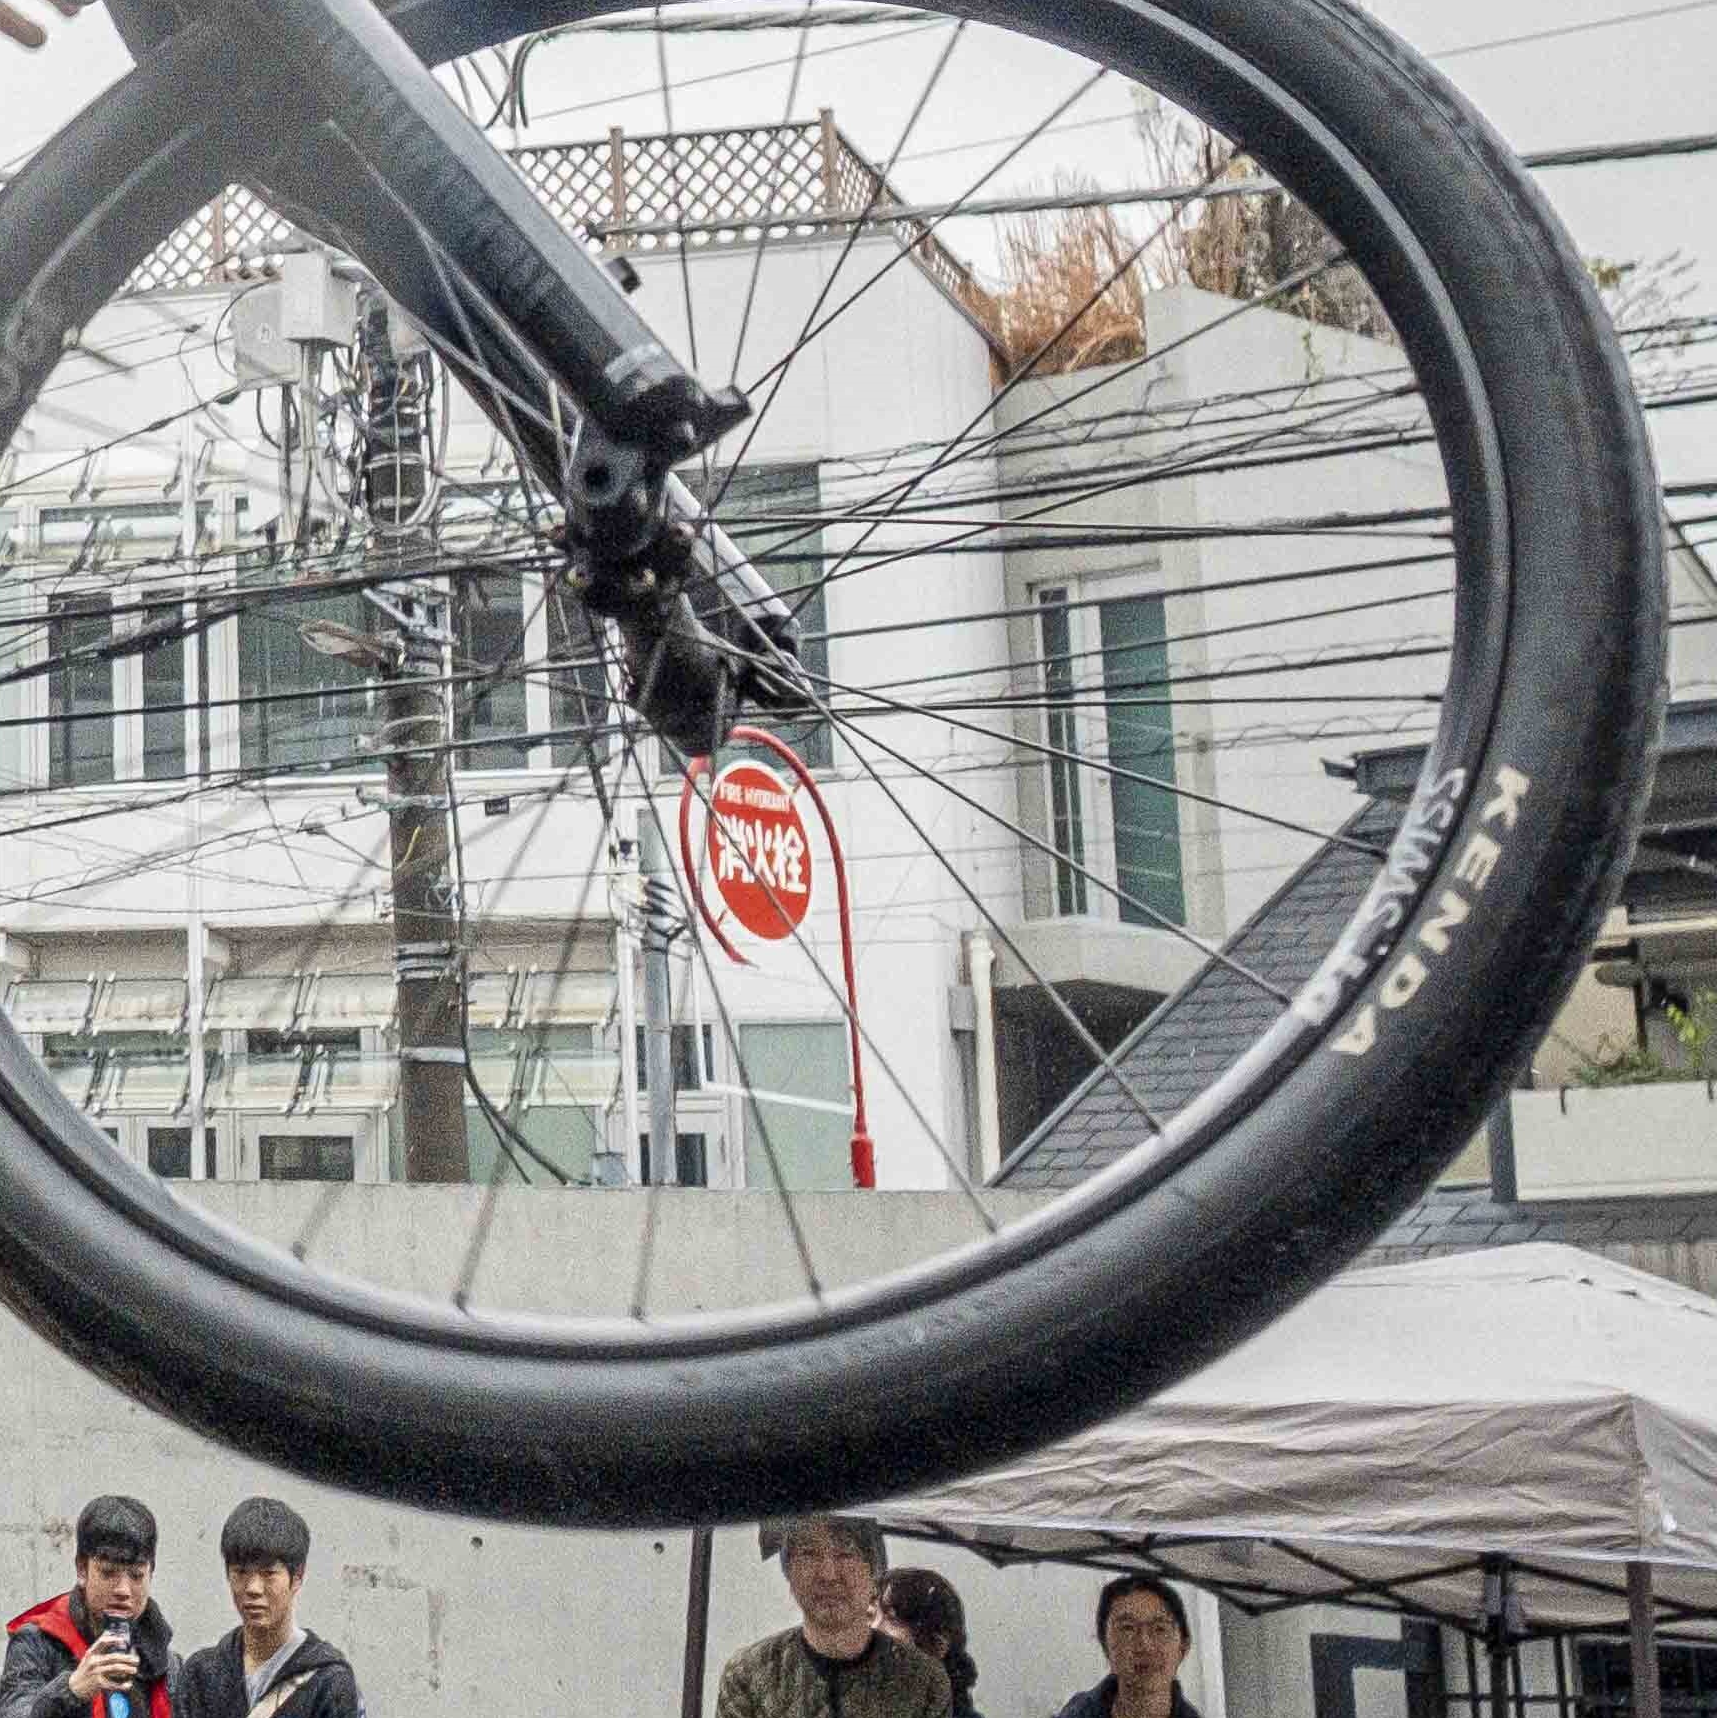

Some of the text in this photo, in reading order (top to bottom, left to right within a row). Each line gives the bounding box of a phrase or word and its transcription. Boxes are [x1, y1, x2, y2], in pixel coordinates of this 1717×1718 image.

[715, 811, 807, 893] 消火栓
[1327, 764, 1532, 1056] KENDA
